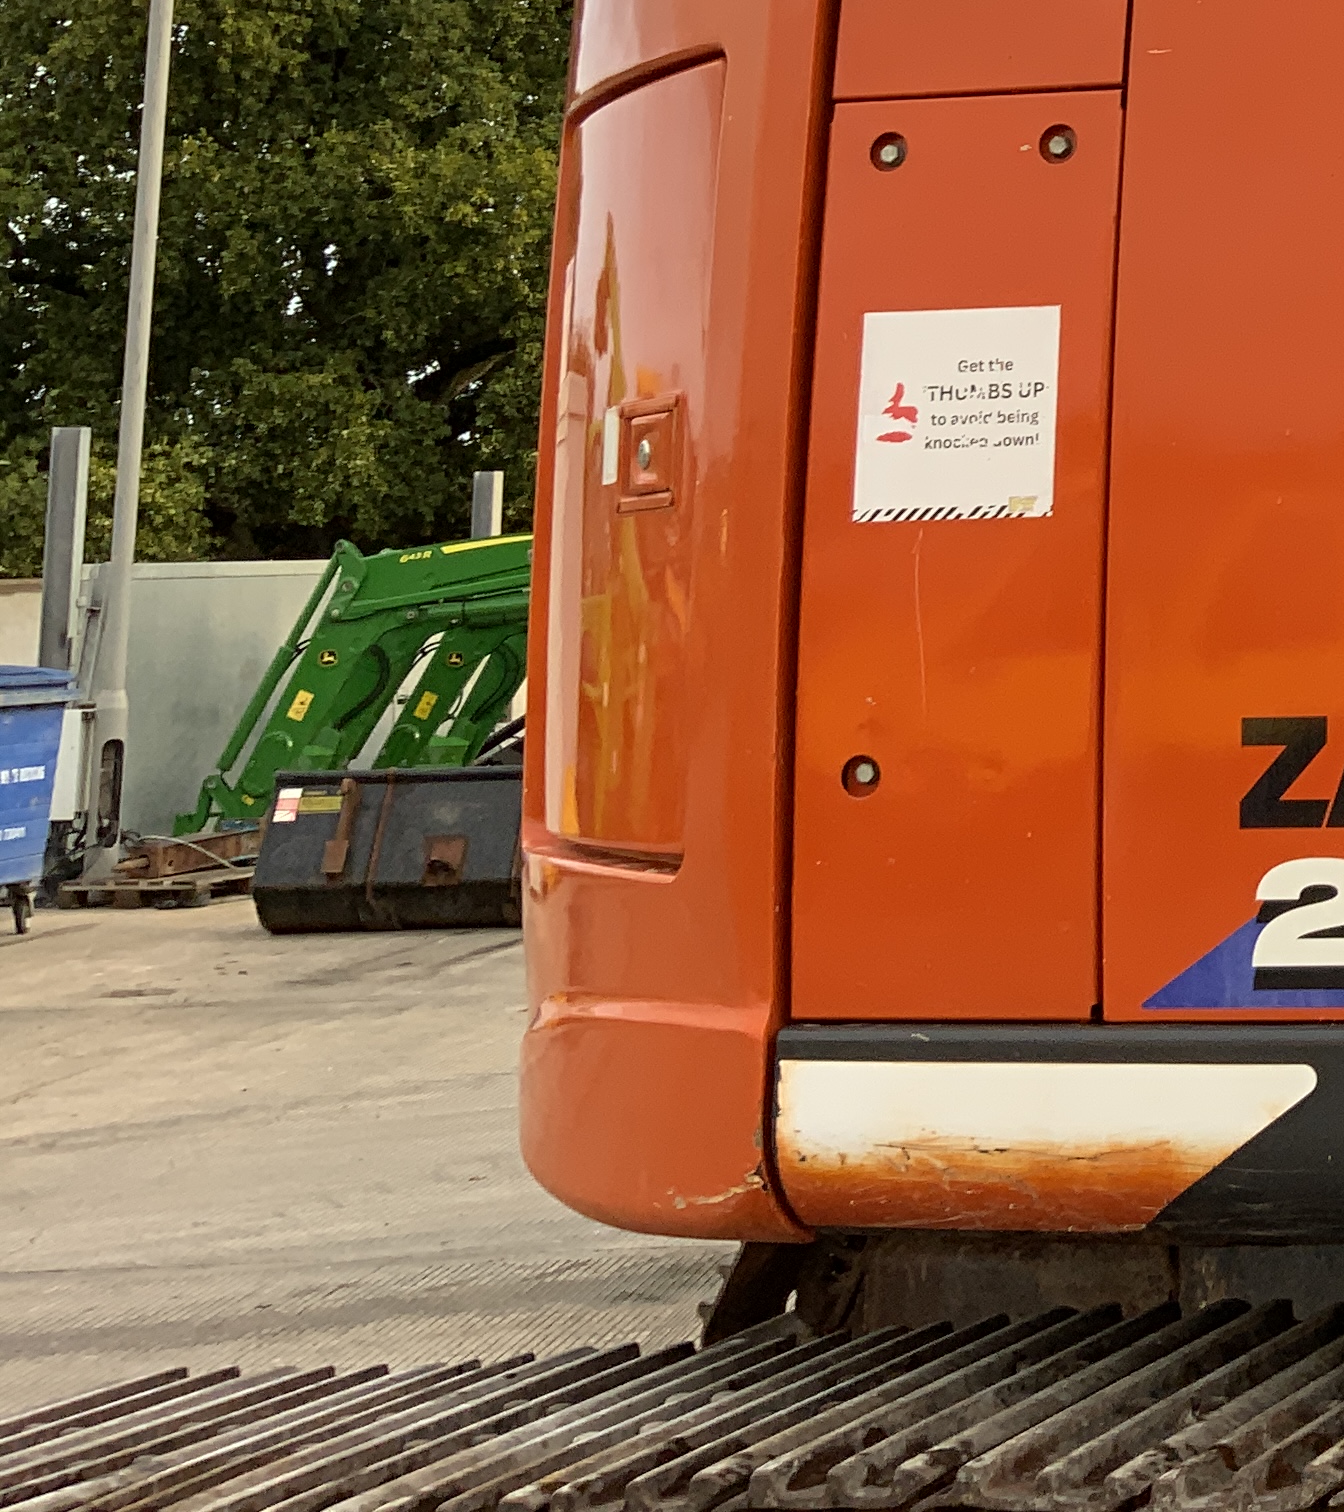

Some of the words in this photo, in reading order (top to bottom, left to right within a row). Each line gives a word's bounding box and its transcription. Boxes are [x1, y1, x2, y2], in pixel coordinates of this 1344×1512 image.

[957, 359, 985, 373] Get
[988, 357, 1014, 372] the
[1018, 381, 1045, 399] UP
[930, 413, 947, 426] to
[997, 409, 1040, 426] being
